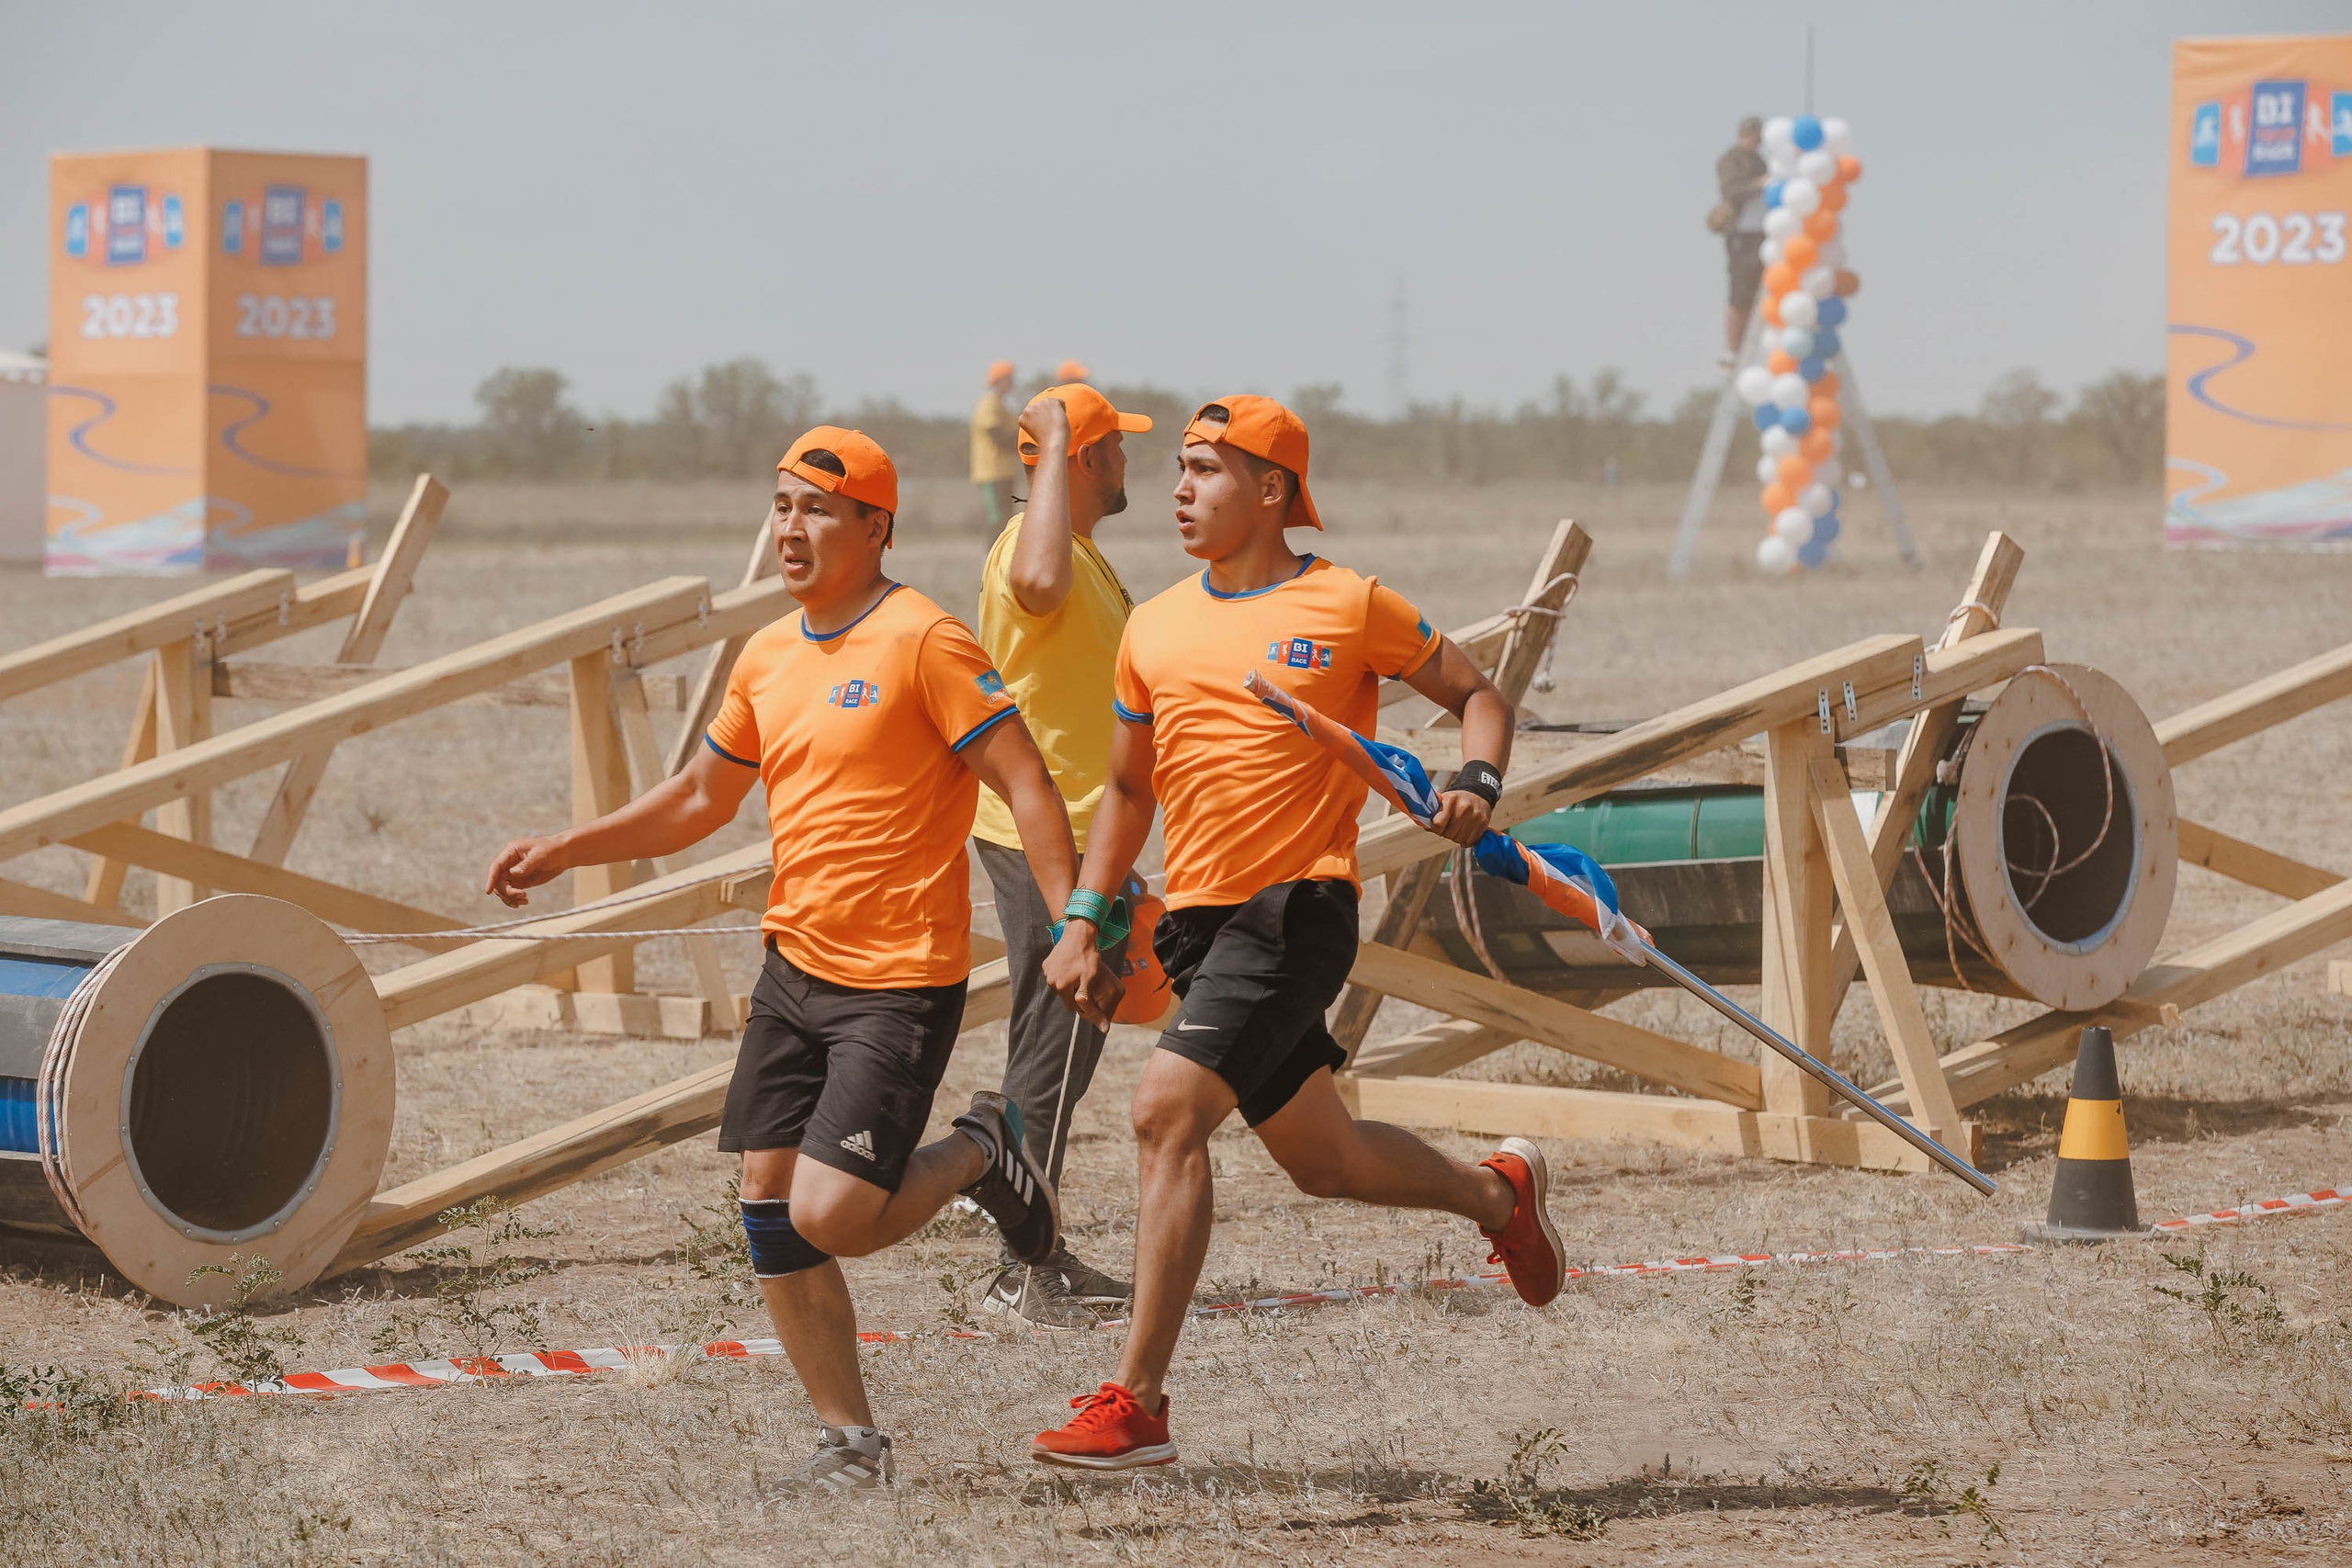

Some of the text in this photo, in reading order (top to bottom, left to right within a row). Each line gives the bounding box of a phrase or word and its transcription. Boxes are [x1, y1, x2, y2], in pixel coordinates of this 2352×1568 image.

[2209, 211, 2346, 265] 2023
[82, 293, 179, 339] 2023
[236, 294, 337, 340] 2023
[1293, 642, 1308, 653] BI
[848, 683, 861, 693] BI
[840, 1140, 876, 1161] adidas
